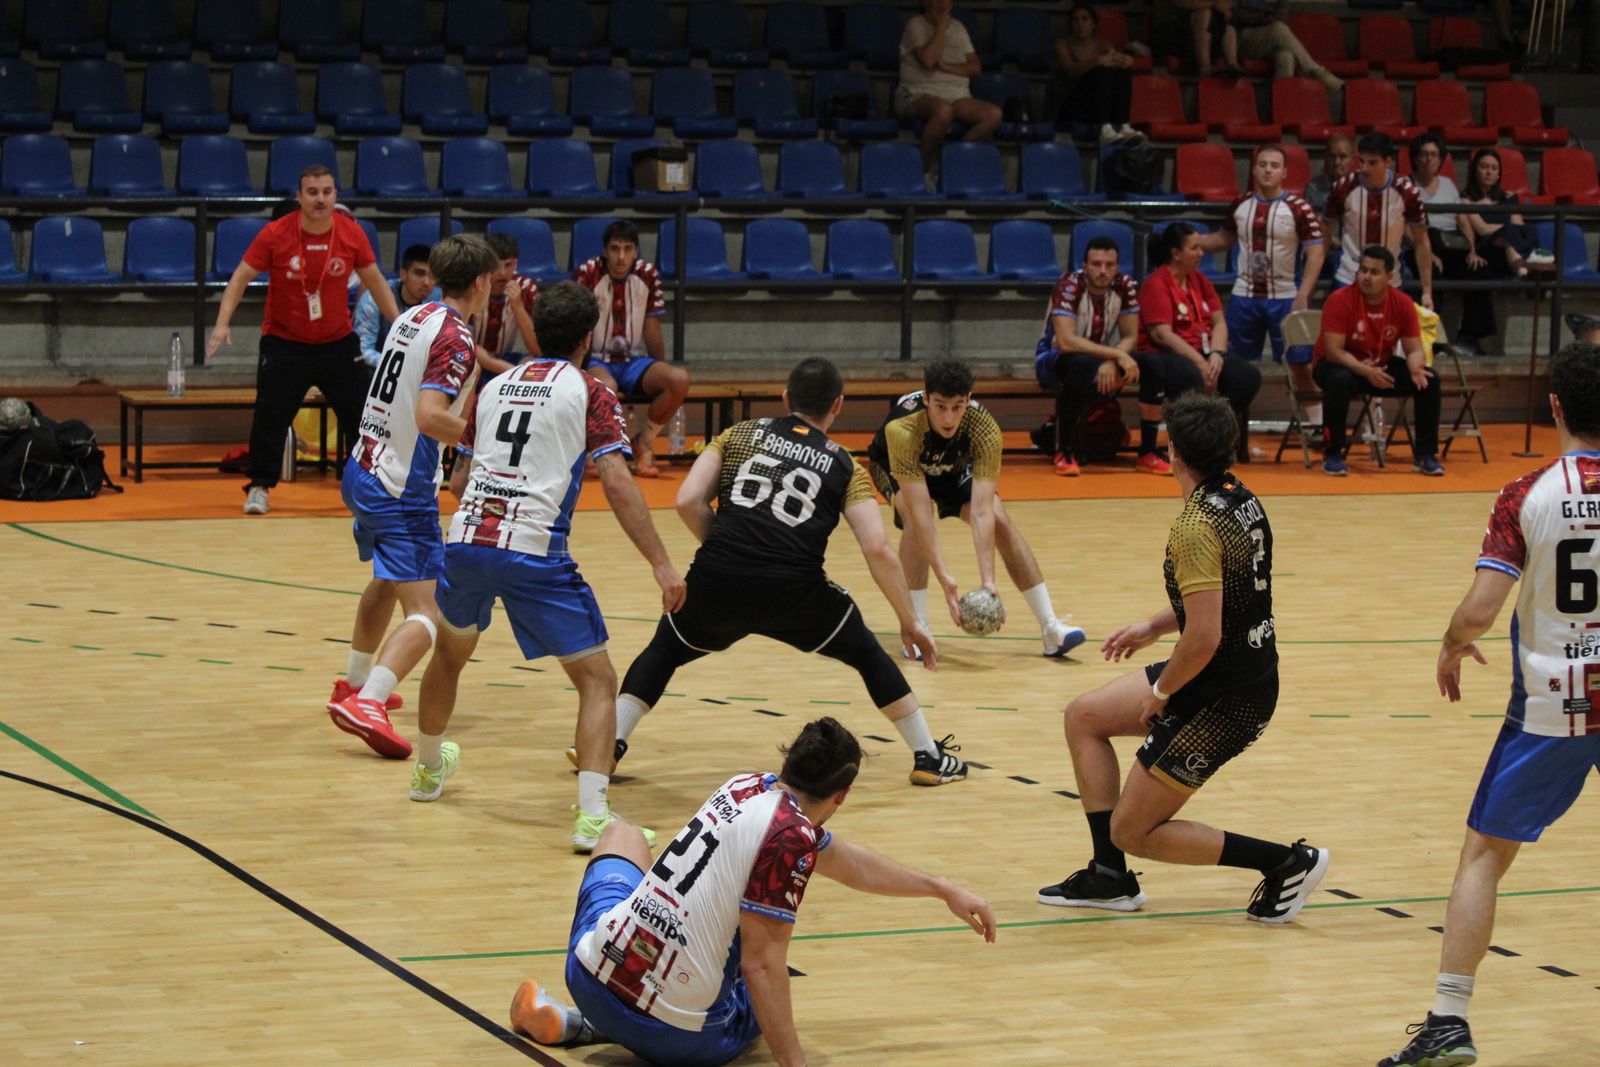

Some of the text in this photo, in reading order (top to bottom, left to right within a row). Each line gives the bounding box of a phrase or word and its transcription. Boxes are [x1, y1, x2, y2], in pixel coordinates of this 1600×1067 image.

[370, 348, 405, 405] 18
[495, 409, 532, 467] 4
[752, 429, 834, 474] P.BARANYAI
[730, 454, 822, 528] 68
[1562, 500, 1600, 518] G.CA
[651, 817, 720, 897] 27
[643, 893, 683, 929] tercer
